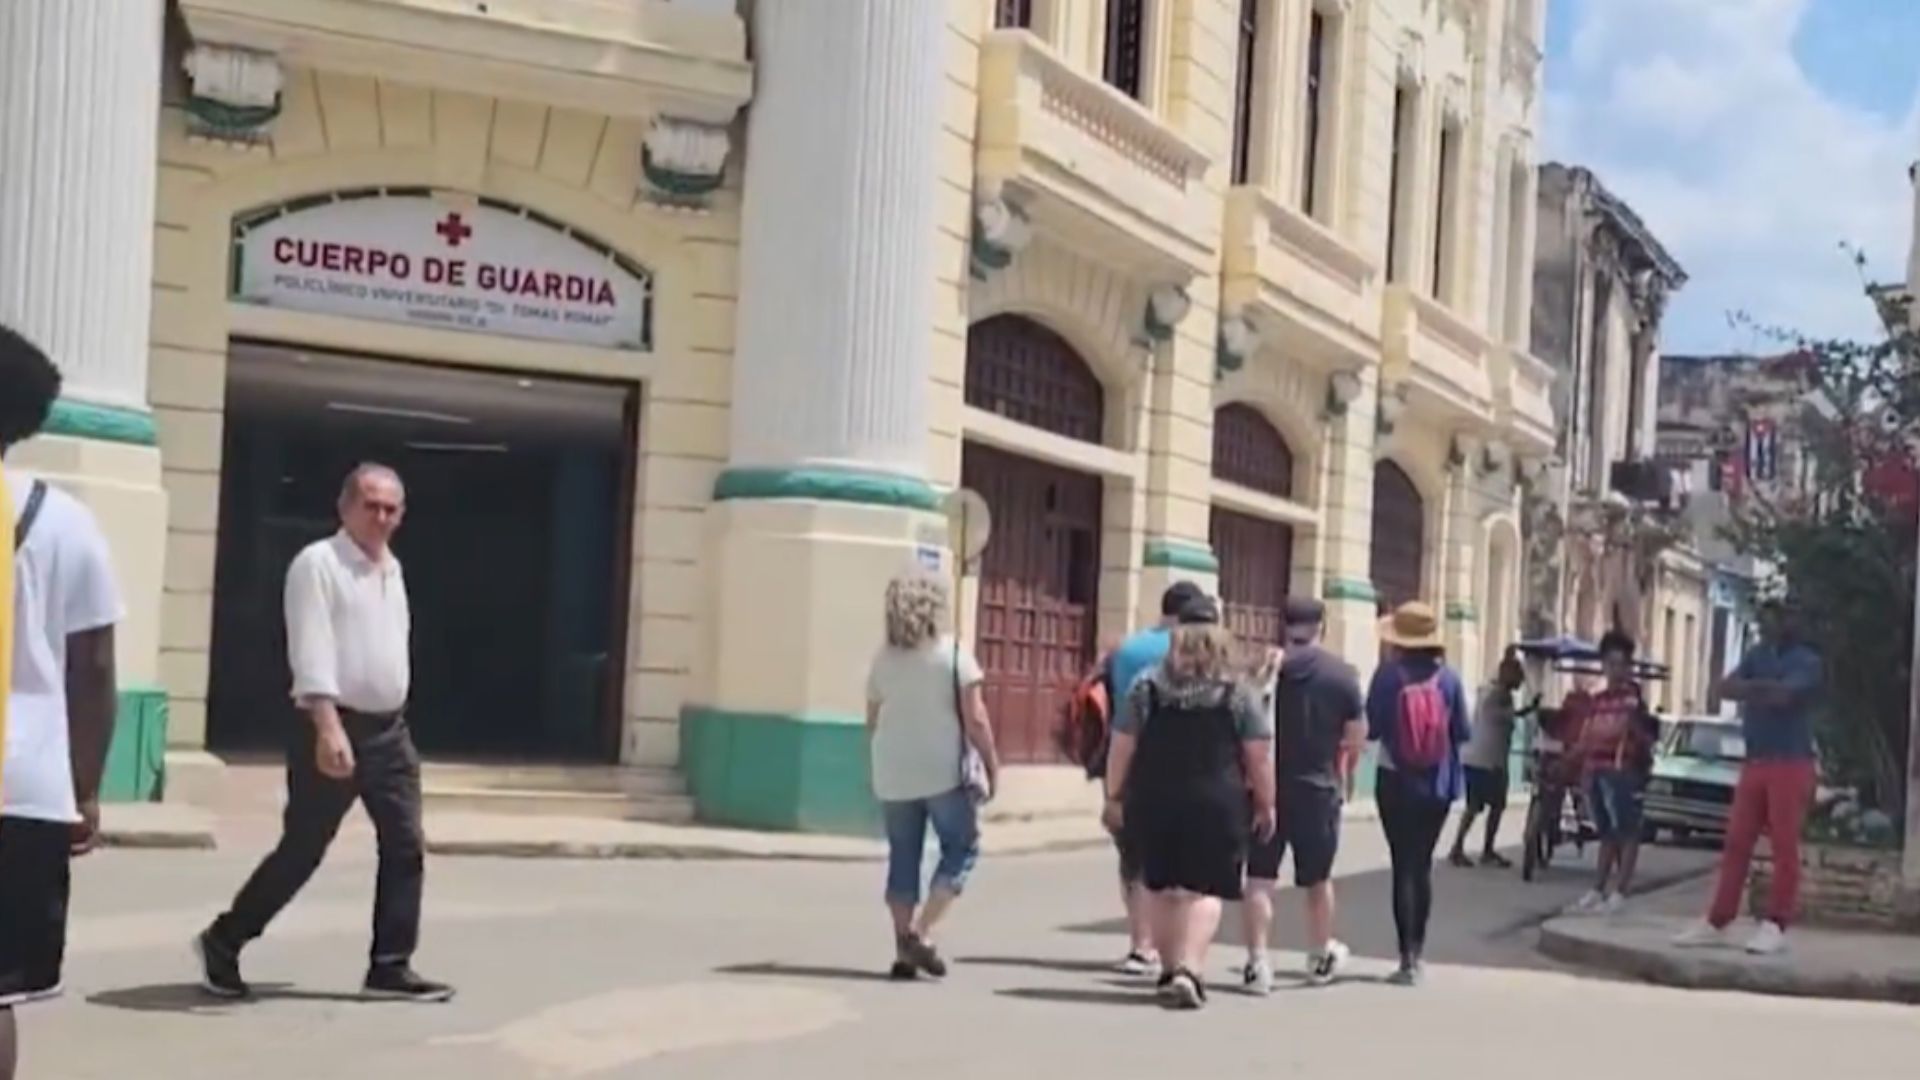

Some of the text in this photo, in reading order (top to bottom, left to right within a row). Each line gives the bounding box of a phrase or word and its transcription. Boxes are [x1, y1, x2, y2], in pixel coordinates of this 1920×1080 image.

[274, 236, 616, 307] CUERPO DE GUARDIA
